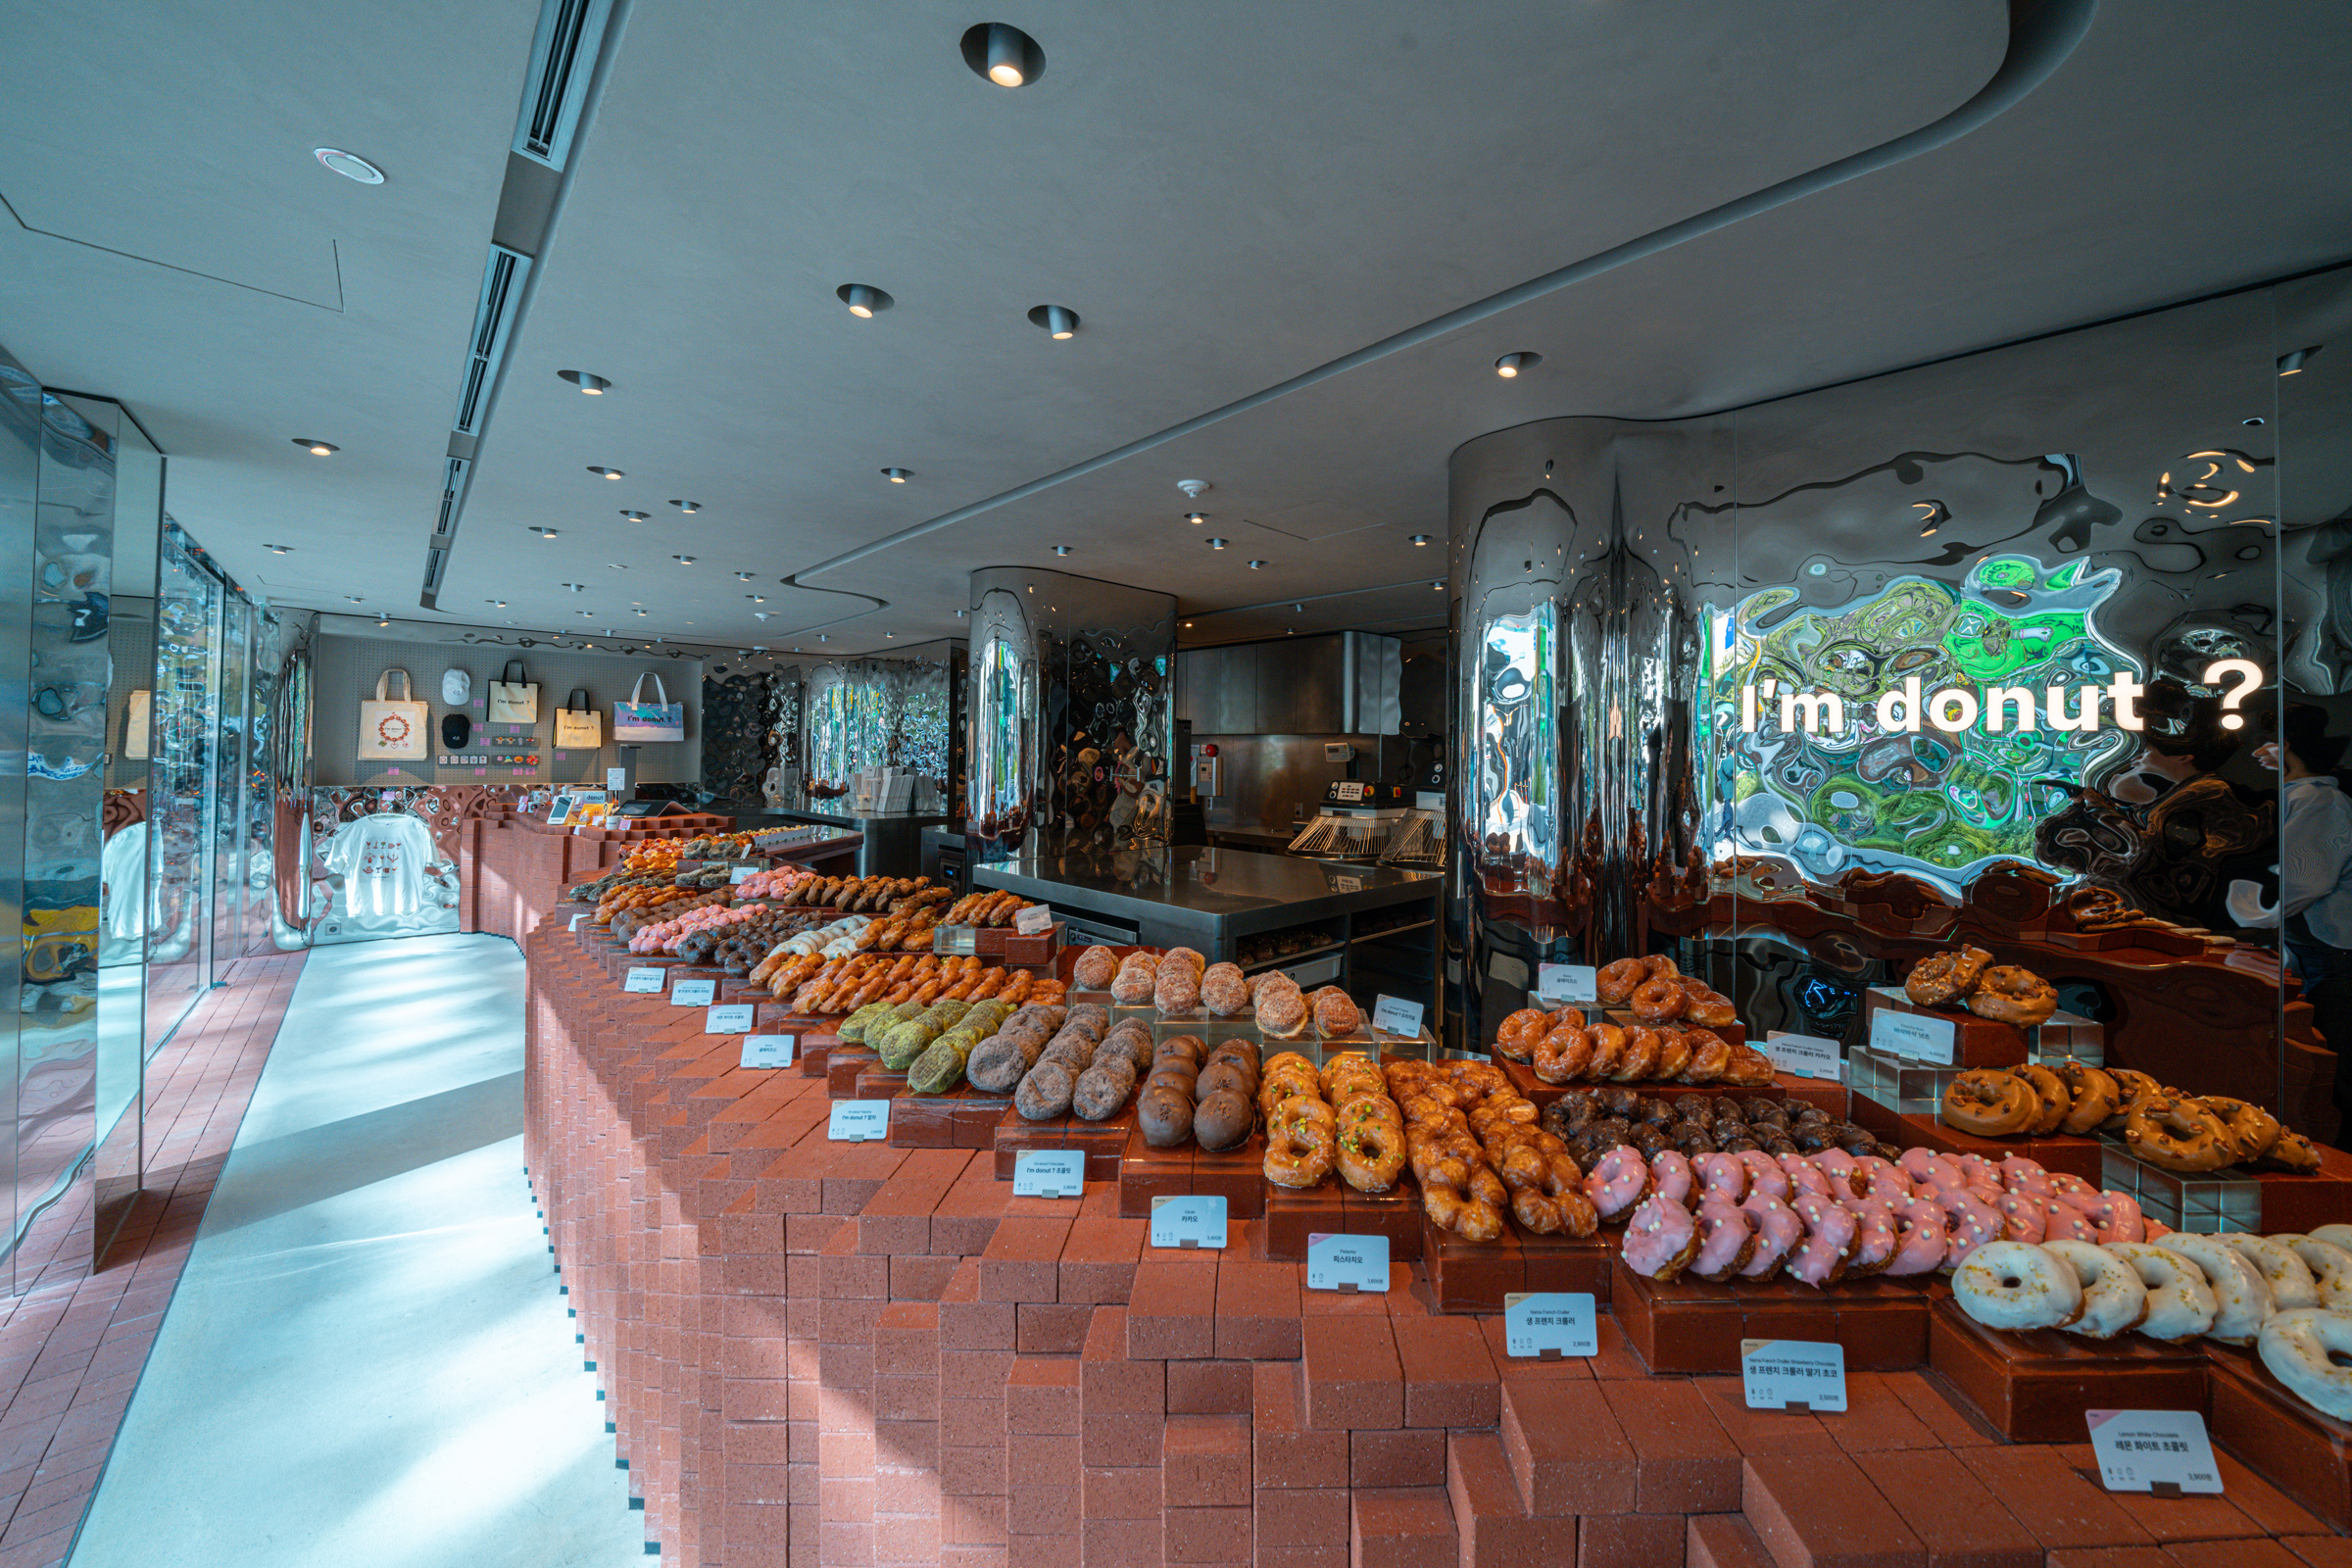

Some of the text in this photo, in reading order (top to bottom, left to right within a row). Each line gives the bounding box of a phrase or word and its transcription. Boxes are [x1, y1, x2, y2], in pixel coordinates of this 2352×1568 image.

[1741, 659, 2264, 733] I'm donut ?
[1893, 1027, 1917, 1037] 바삭바삭
[1815, 1052, 1832, 1060] 카카오
[1333, 1254, 1363, 1264] 피스타치오
[1526, 1316, 1576, 1326] 생 프렌치 크룰러
[1749, 1365, 1838, 1378] 생 프렌치 크룰러 딸기 초코
[2115, 1440, 2189, 1452] 레몬 화이트 초콜릿
[2187, 1472, 2213, 1482] 3,900원
